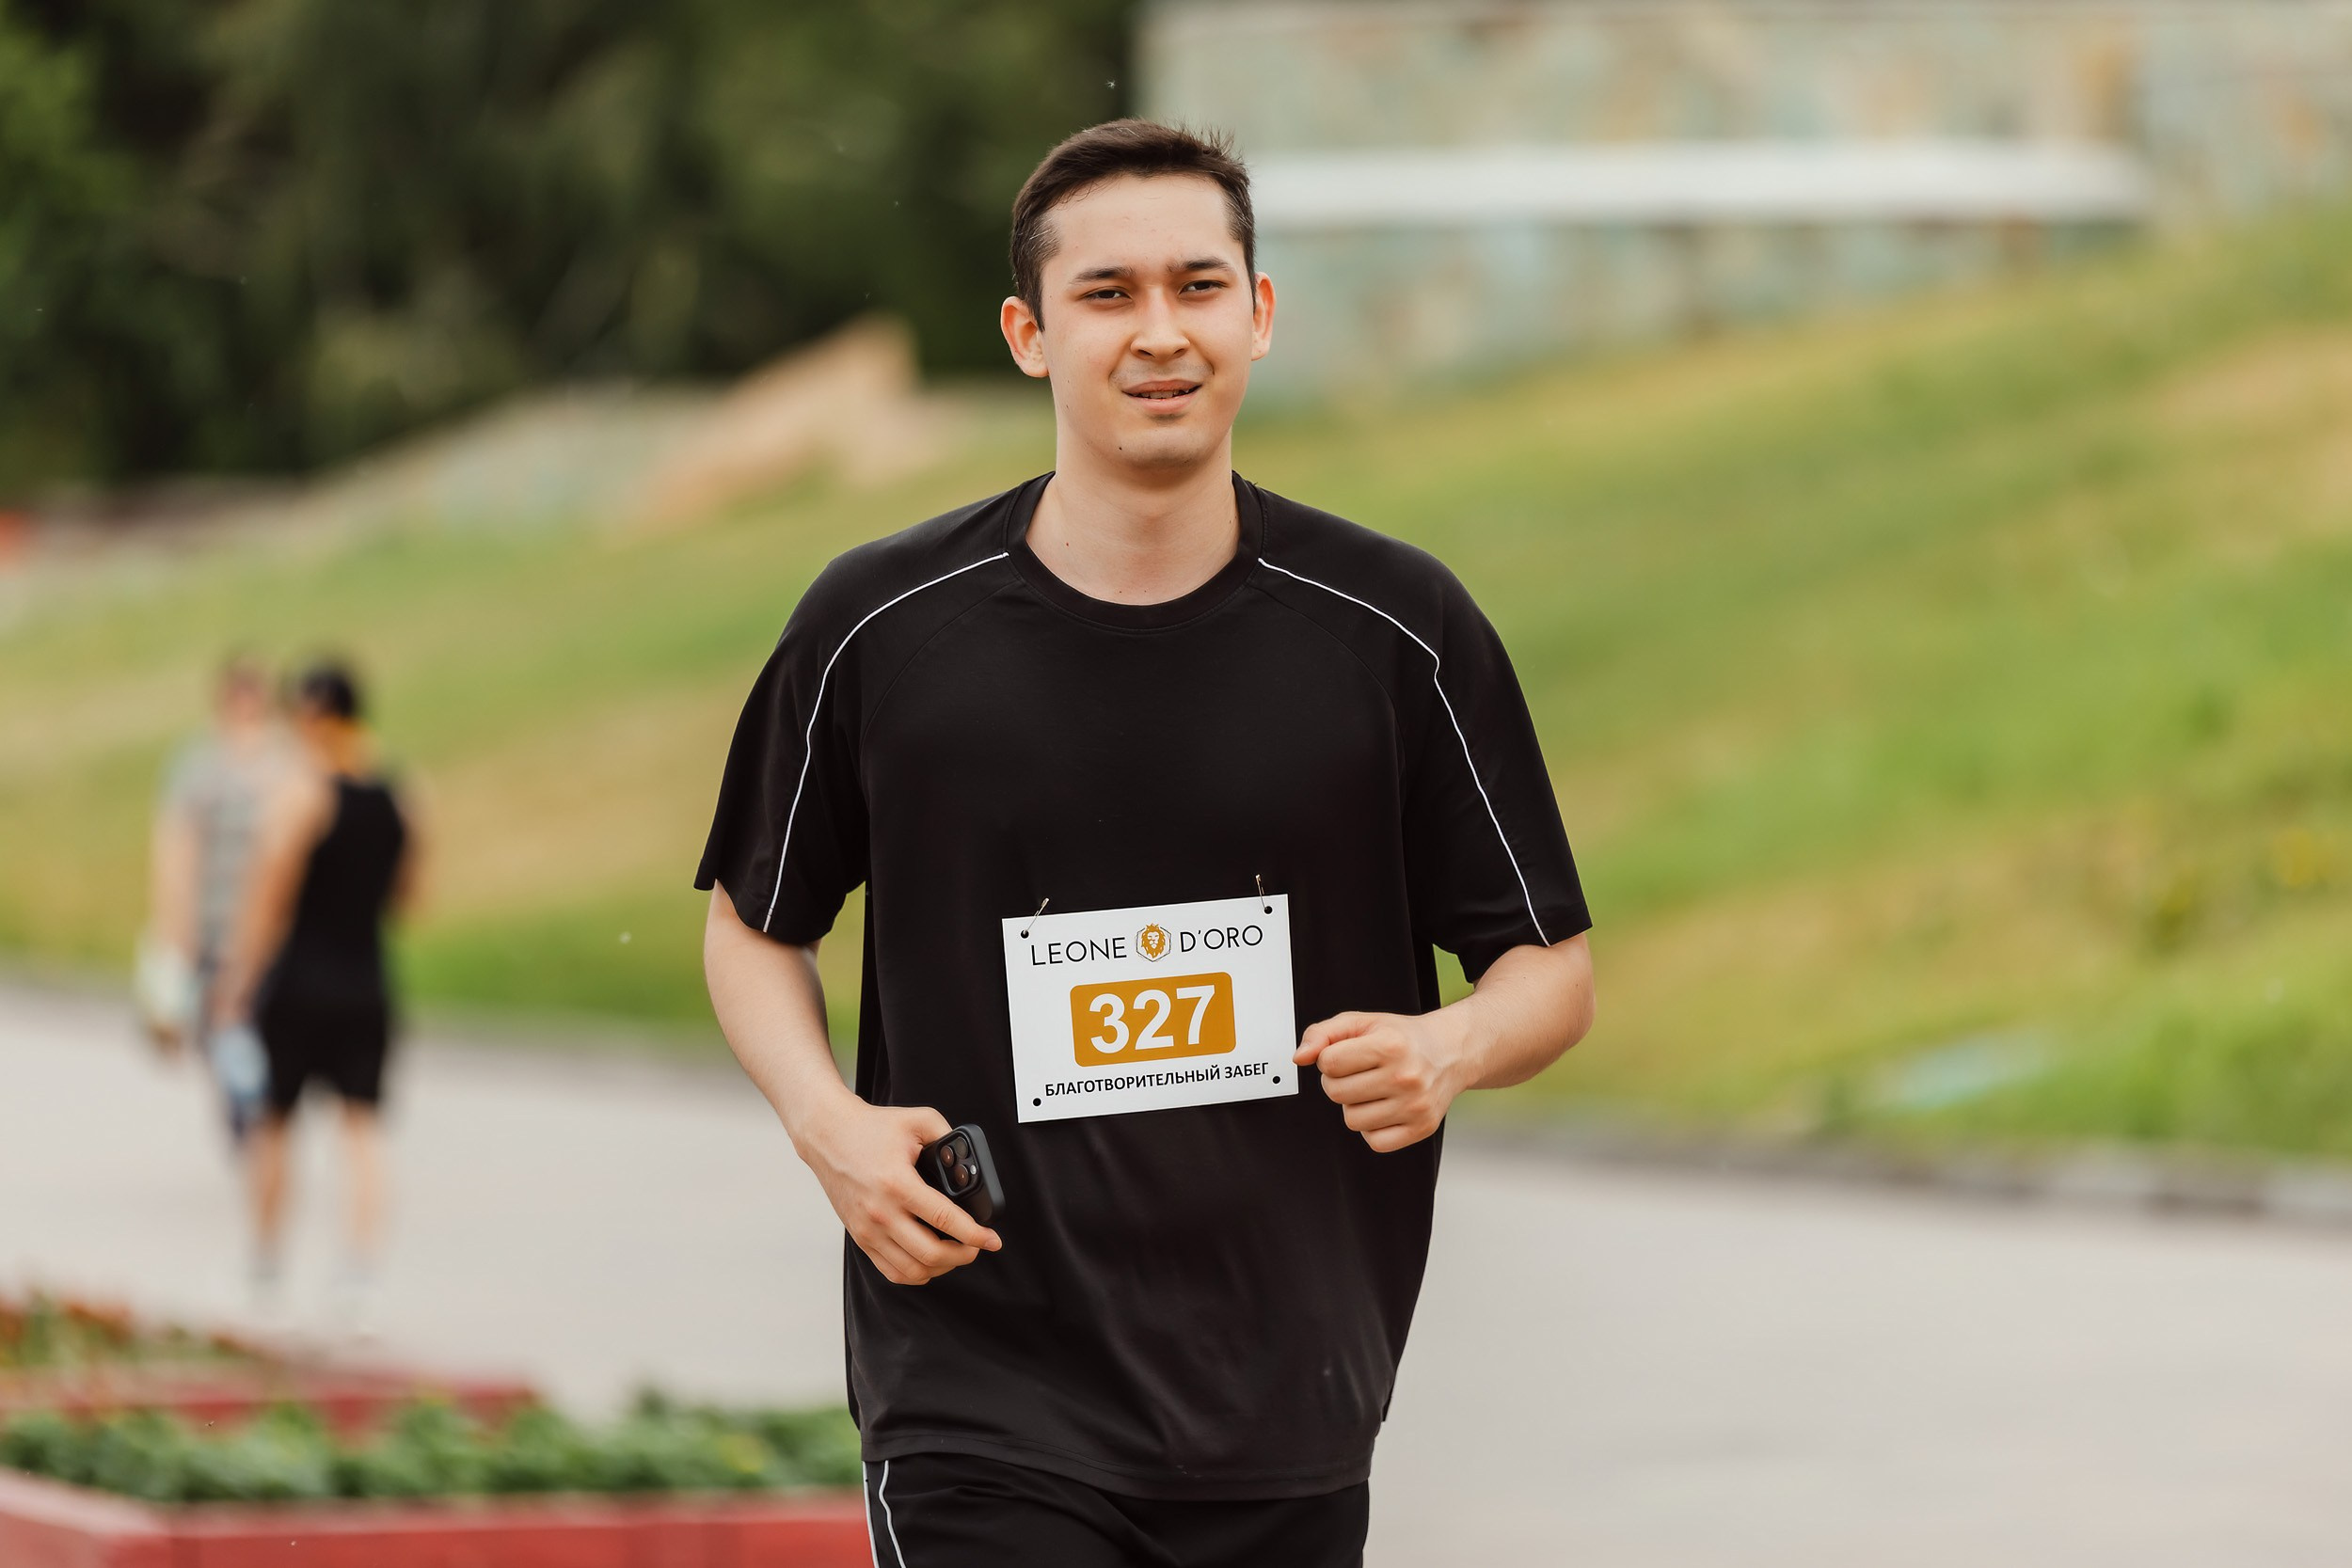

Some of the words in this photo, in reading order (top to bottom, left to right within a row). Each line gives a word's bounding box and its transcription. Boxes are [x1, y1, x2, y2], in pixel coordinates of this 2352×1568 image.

[1031, 936, 1127, 966] LEONE
[1180, 925, 1263, 953] D'ORO
[1089, 984, 1216, 1054] 327
[1044, 1064, 1221, 1097] БЛАГОТВОРИТЕЛЬНЫЙ
[1224, 1062, 1269, 1080] ЗАБЕГ
